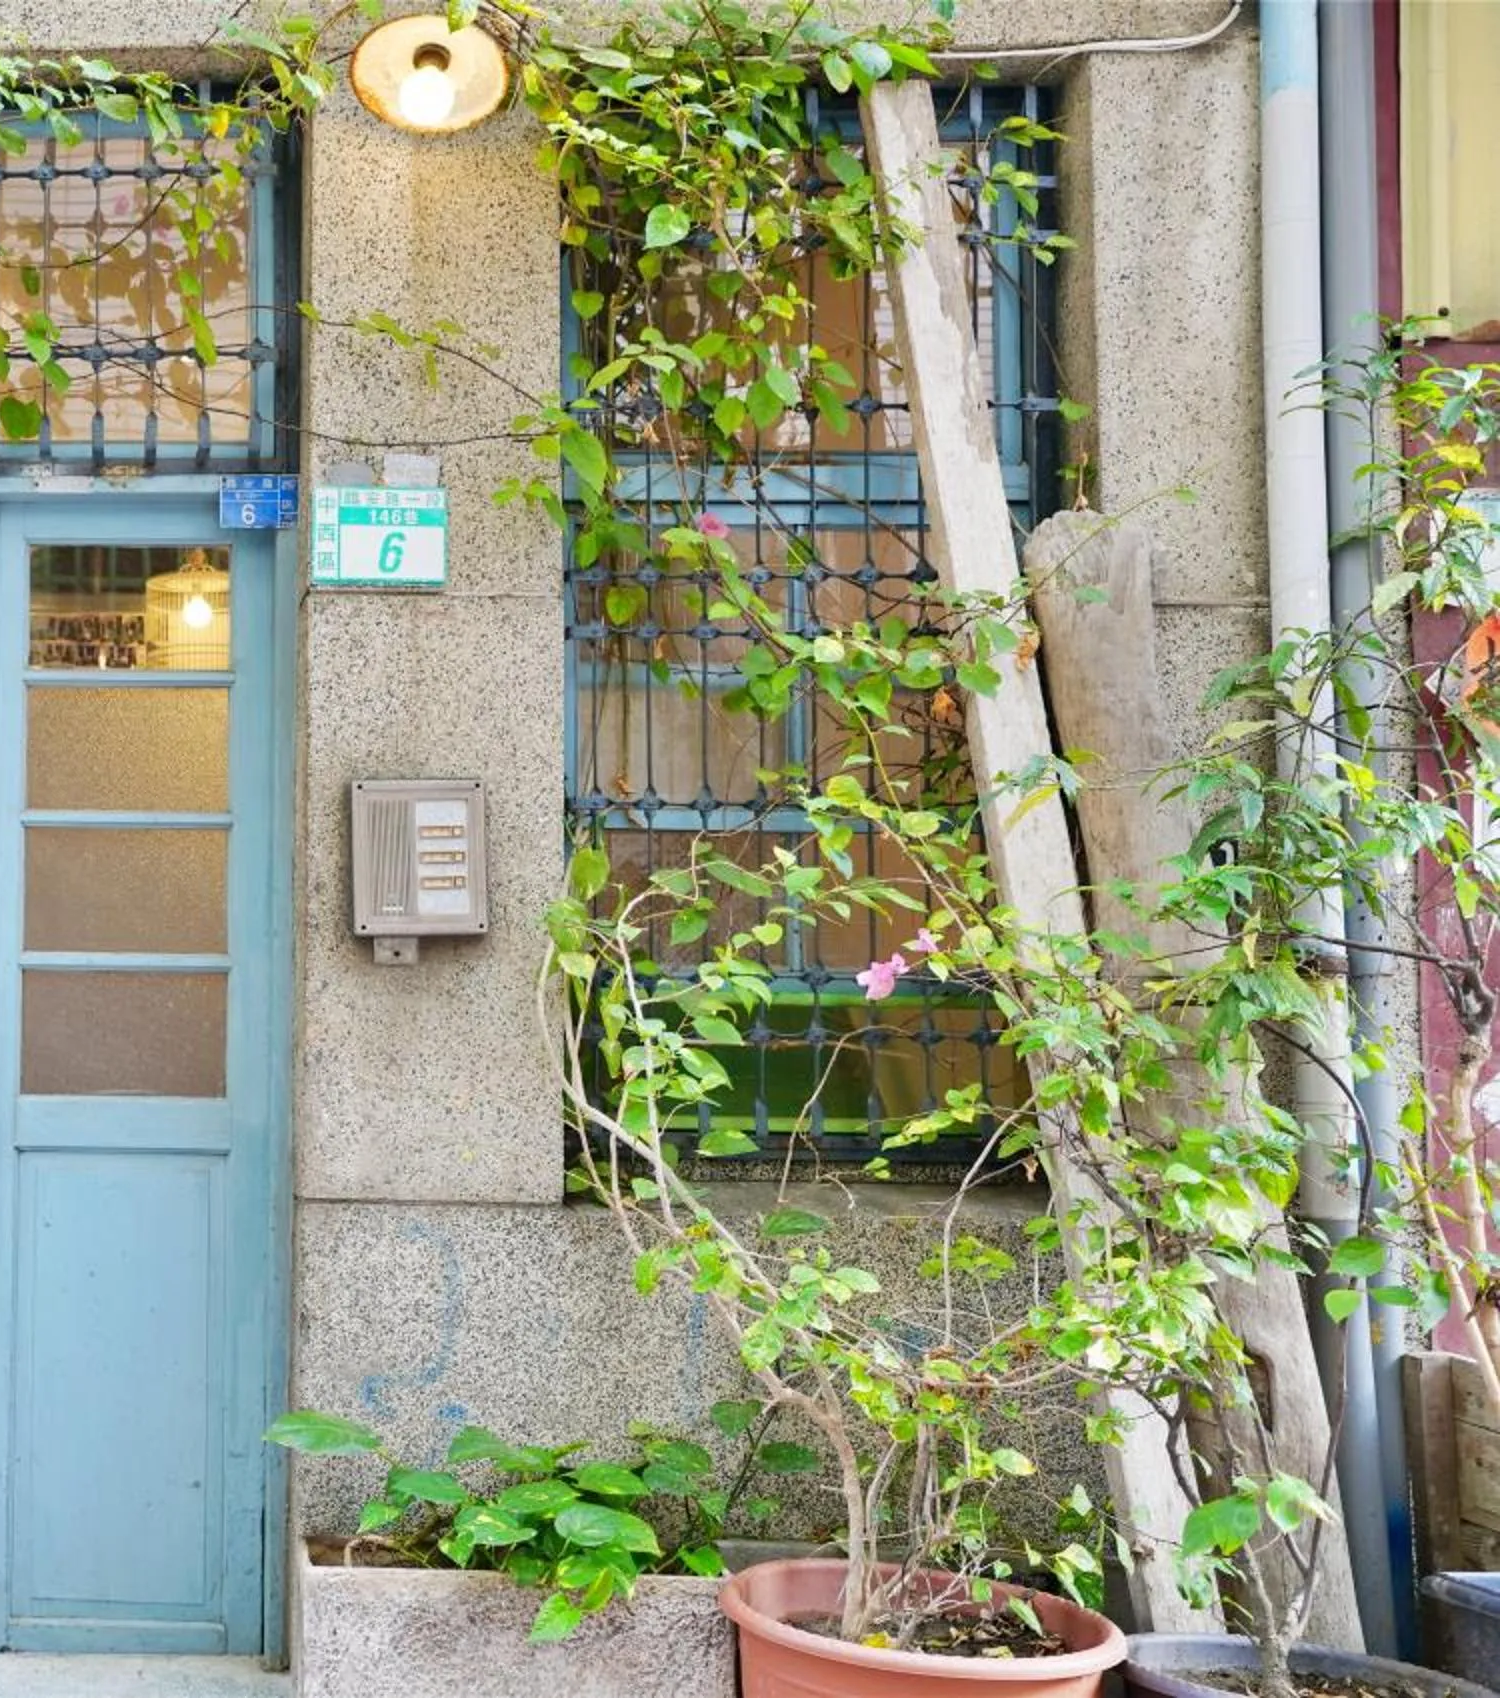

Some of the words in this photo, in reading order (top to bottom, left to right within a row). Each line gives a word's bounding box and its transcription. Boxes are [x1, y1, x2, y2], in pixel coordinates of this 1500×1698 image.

[242, 503, 256, 525] 6
[317, 496, 336, 571] 中西區
[378, 531, 406, 574] 6
